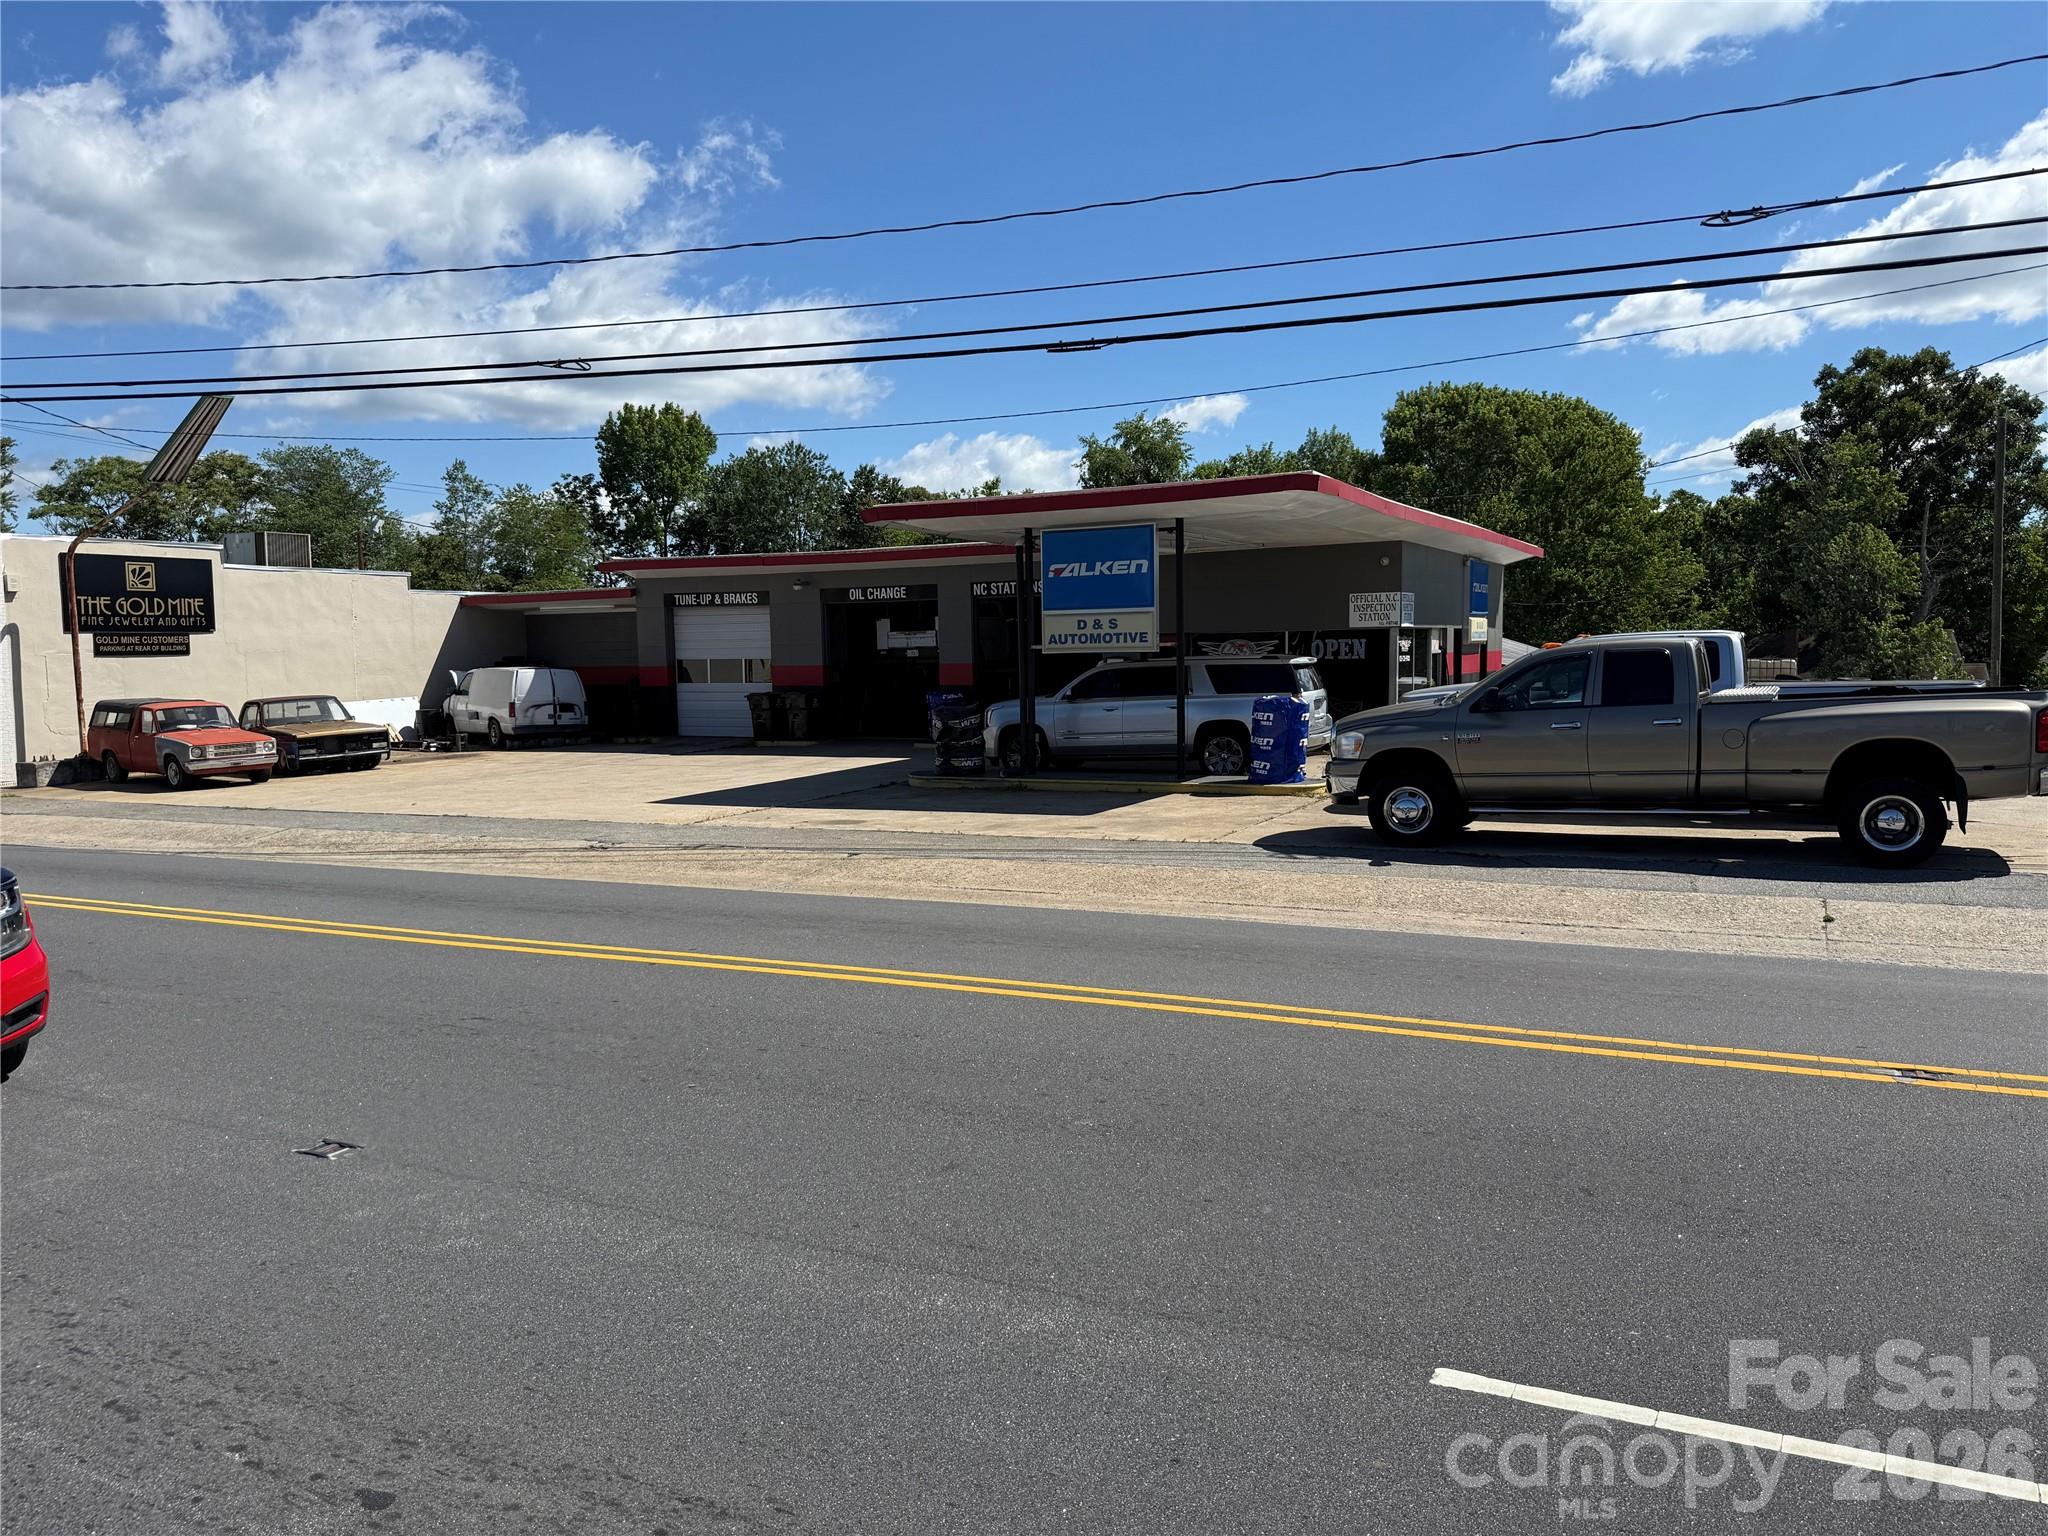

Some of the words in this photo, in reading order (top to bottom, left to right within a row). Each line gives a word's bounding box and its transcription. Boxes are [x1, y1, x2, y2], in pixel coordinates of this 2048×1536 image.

[1048, 559, 1148, 577] FALKEN
[849, 588, 865, 600] OIL
[867, 586, 907, 599] CHANGE
[973, 583, 987, 595] NC
[674, 593, 712, 605] TUNE-UP
[714, 593, 721, 604] &
[723, 592, 758, 605] BRAKES
[1351, 594, 1383, 603] OFFICIAL
[1386, 593, 1399, 602] N.C.
[77, 596, 112, 615] THE
[115, 597, 165, 616] GOLD
[168, 598, 205, 616] MINE
[1353, 602, 1397, 613] INSPECTION
[81, 616, 105, 626] FINE
[109, 616, 155, 626] JEWELRY
[158, 617, 178, 626] AND
[180, 617, 207, 626] GIFTS
[1359, 612, 1391, 622] STATION
[1077, 619, 1088, 630] D
[1092, 619, 1103, 630] &
[1108, 618, 1119, 630] S
[95, 635, 119, 644] GOLD
[121, 635, 139, 644] MINE
[142, 635, 189, 644] CUSTOMERS
[1048, 631, 1149, 645] AUTOMOTIVE
[1312, 639, 1366, 659] OPEN
